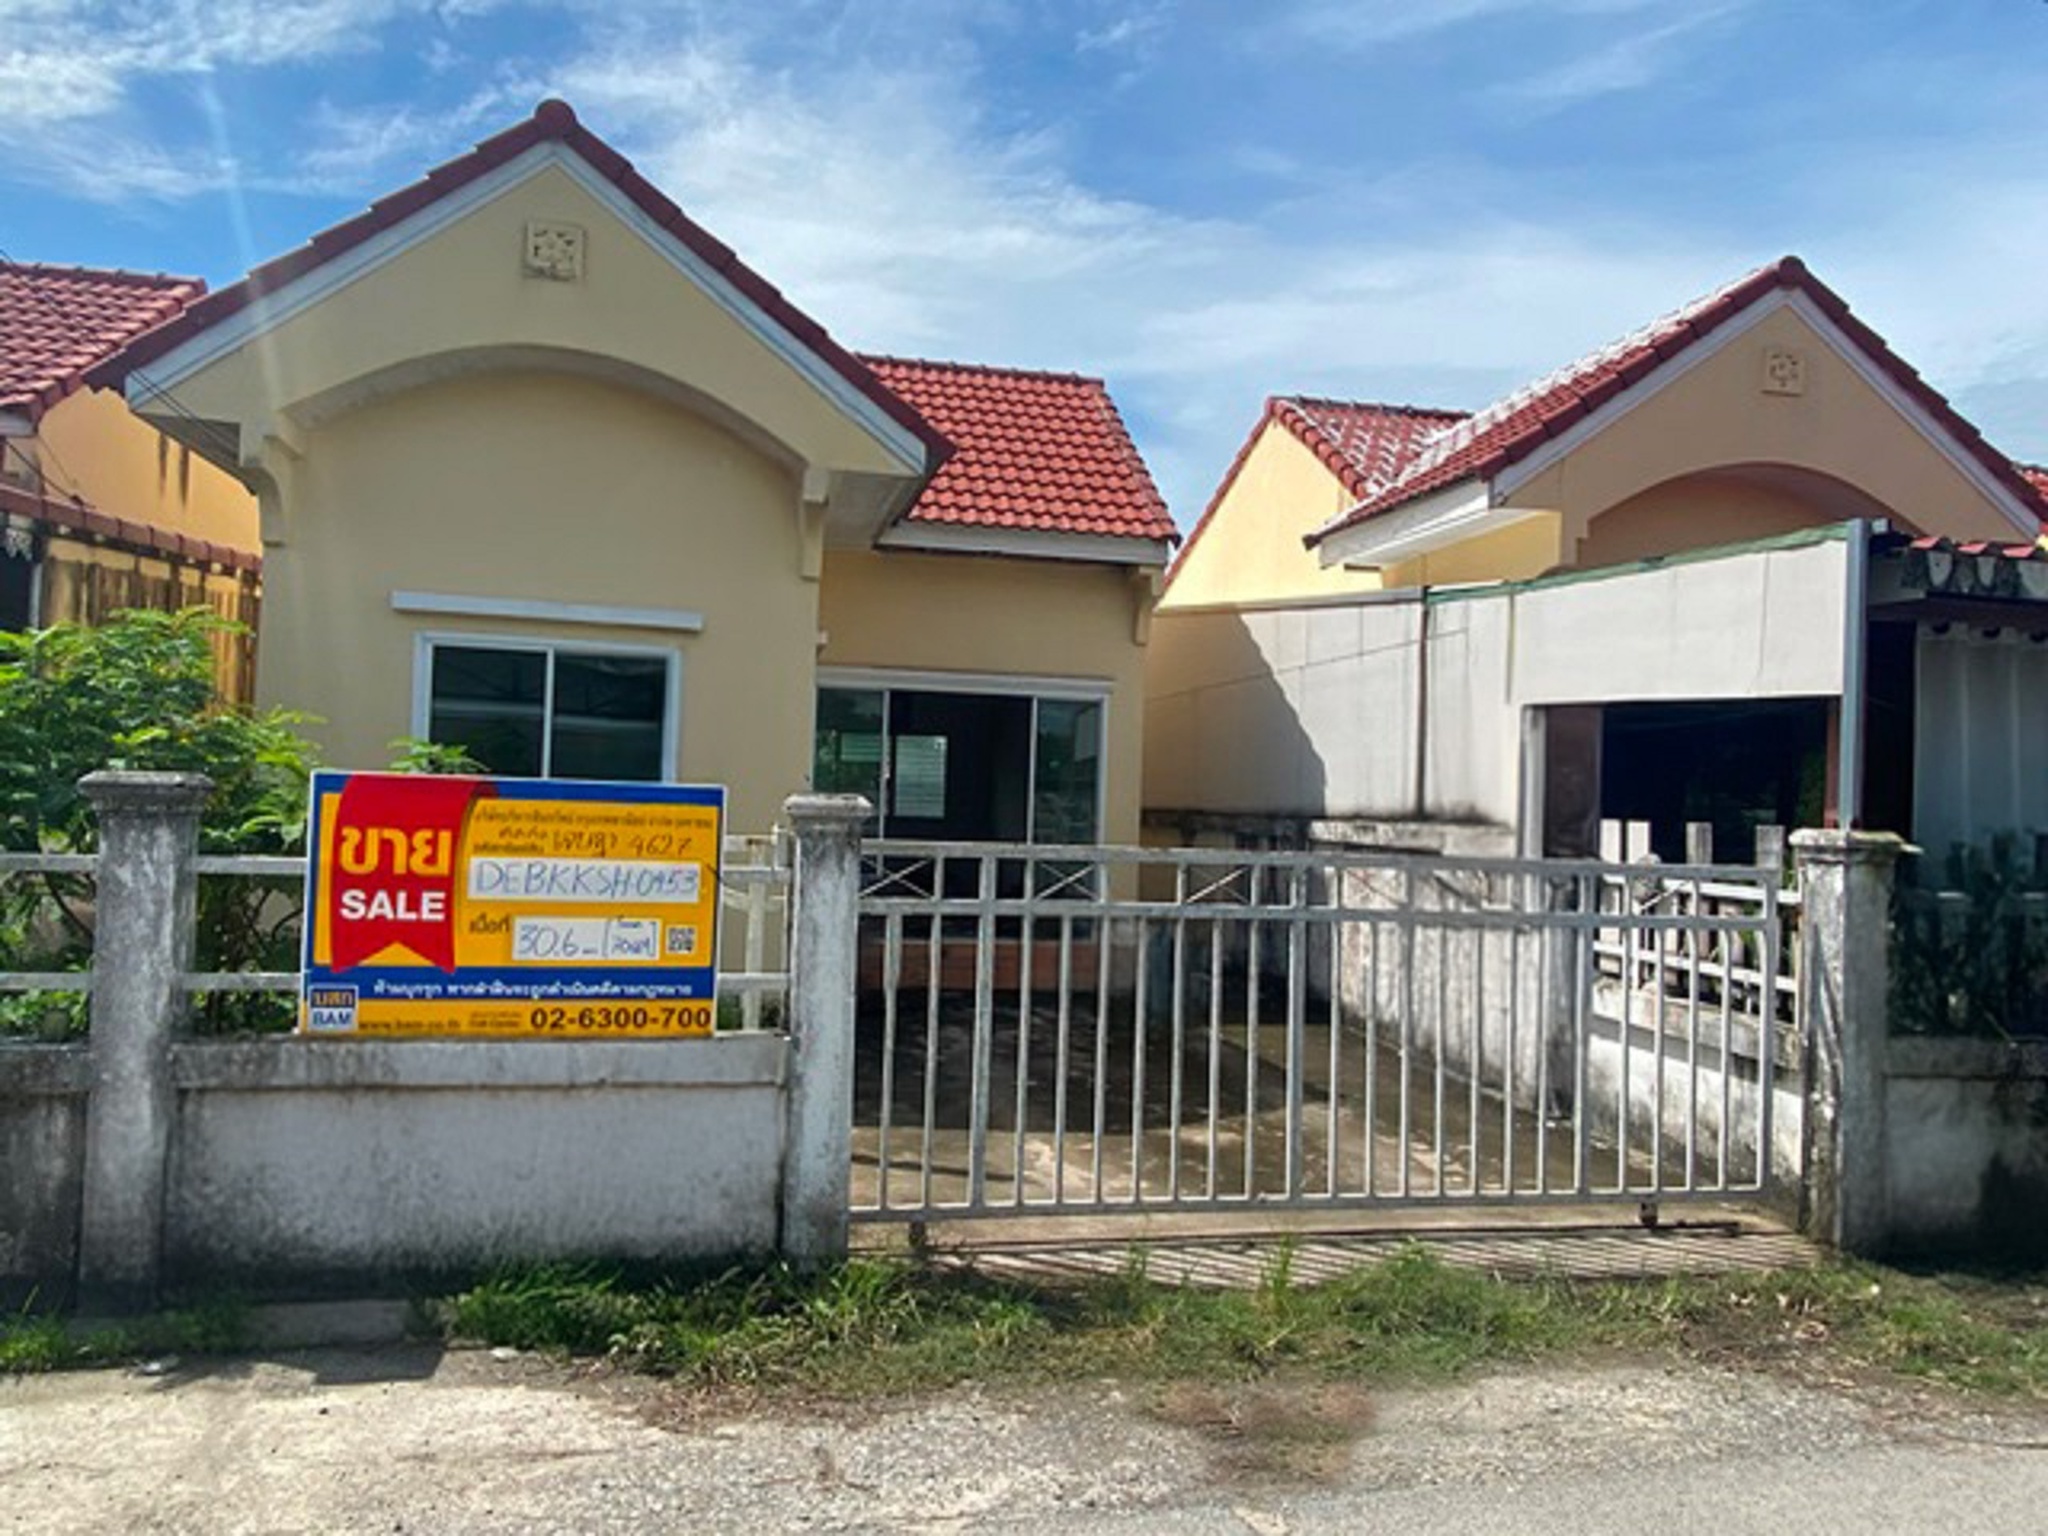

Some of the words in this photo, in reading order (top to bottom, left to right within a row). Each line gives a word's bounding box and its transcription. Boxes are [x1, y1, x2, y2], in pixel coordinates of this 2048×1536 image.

[340, 826, 452, 876] ขาย
[341, 888, 446, 920] SALE
[312, 1010, 353, 1025] BAM
[530, 1007, 711, 1029] 02-6300-700
